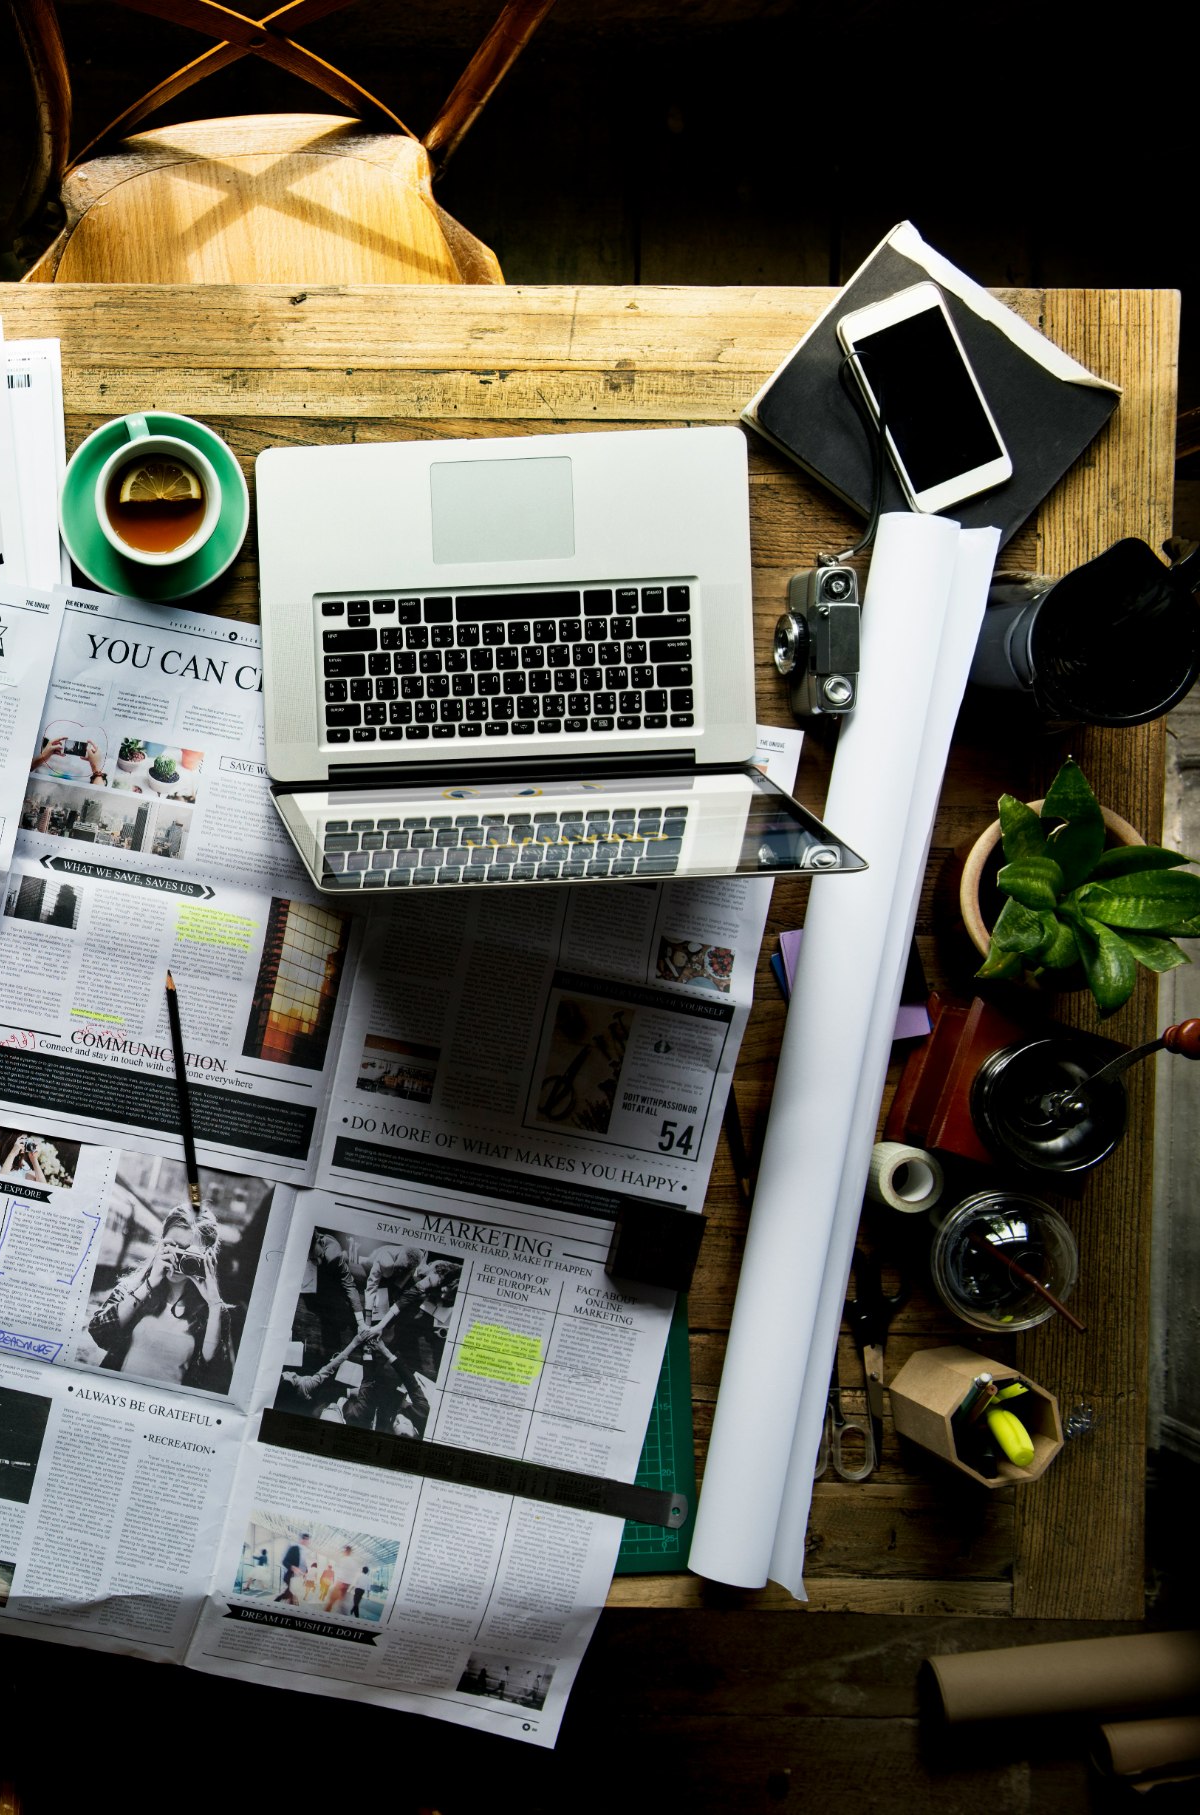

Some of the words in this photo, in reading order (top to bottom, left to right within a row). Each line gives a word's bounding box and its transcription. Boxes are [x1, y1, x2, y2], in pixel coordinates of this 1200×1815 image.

[87, 633, 155, 668] YOU
[160, 650, 229, 684] CAN
[229, 760, 254, 772] SAVE
[63, 860, 94, 874] WHAT
[96, 867, 112, 877] WE
[113, 870, 142, 885] SAVE,
[145, 876, 178, 890] SAVES
[180, 883, 193, 894] US
[70, 1029, 226, 1072] COMMUNICTION
[39, 1039, 73, 1053] Connect
[74, 1048, 90, 1056] and
[91, 1051, 108, 1061] stay
[110, 1053, 119, 1062] in
[120, 1056, 144, 1067] touch
[146, 1062, 164, 1072] with
[166, 1065, 204, 1079] evyone
[205, 1074, 253, 1089] everywhere
[621, 1101, 636, 1111] NOT
[635, 1104, 645, 1114] AT
[644, 1106, 658, 1117] ALL
[623, 1092, 633, 1101] DO
[632, 1094, 640, 1102] IT
[640, 1095, 658, 1106] WITH
[657, 1098, 688, 1112] PASSION
[687, 1105, 697, 1114] OR
[658, 1122, 693, 1155] 54
[350, 1115, 376, 1132] DO
[380, 1121, 431, 1144] MORE
[435, 1133, 458, 1148] OF
[462, 1137, 512, 1159] WHAT
[514, 1148, 575, 1172] MAKES
[581, 1161, 617, 1181] YOU
[620, 1169, 679, 1192] HAPPY
[4, 1184, 41, 1198] EXPLORE
[422, 1215, 552, 1257] MARKETING
[376, 1222, 401, 1234] STAY
[401, 1227, 446, 1246] POSITIVE,
[449, 1238, 478, 1252] WORK
[480, 1245, 510, 1260] HARD,
[512, 1252, 541, 1266] MAKE
[543, 1259, 554, 1268] IT
[554, 1261, 592, 1277] HAPPEN
[476, 1272, 496, 1284] THE
[497, 1277, 551, 1296] EUROPEAN
[483, 1264, 534, 1282] ECONOMY
[534, 1275, 549, 1285] OF
[496, 1287, 529, 1302] UNION
[576, 1284, 602, 1297] FACT
[601, 1291, 638, 1305] ABOUT
[585, 1297, 622, 1312] ONLINE
[573, 1304, 633, 1325] MARKETING
[75, 1388, 126, 1407] ALWAYS
[129, 1399, 145, 1412] BE
[148, 1404, 213, 1426] GRATEFUL
[148, 1434, 211, 1454] RECREATION
[240, 1609, 278, 1623] DREAM
[280, 1617, 291, 1626] IT,
[295, 1620, 321, 1631] WISH
[322, 1625, 333, 1634] IT,
[335, 1628, 352, 1636] DO
[353, 1631, 364, 1639] IT
